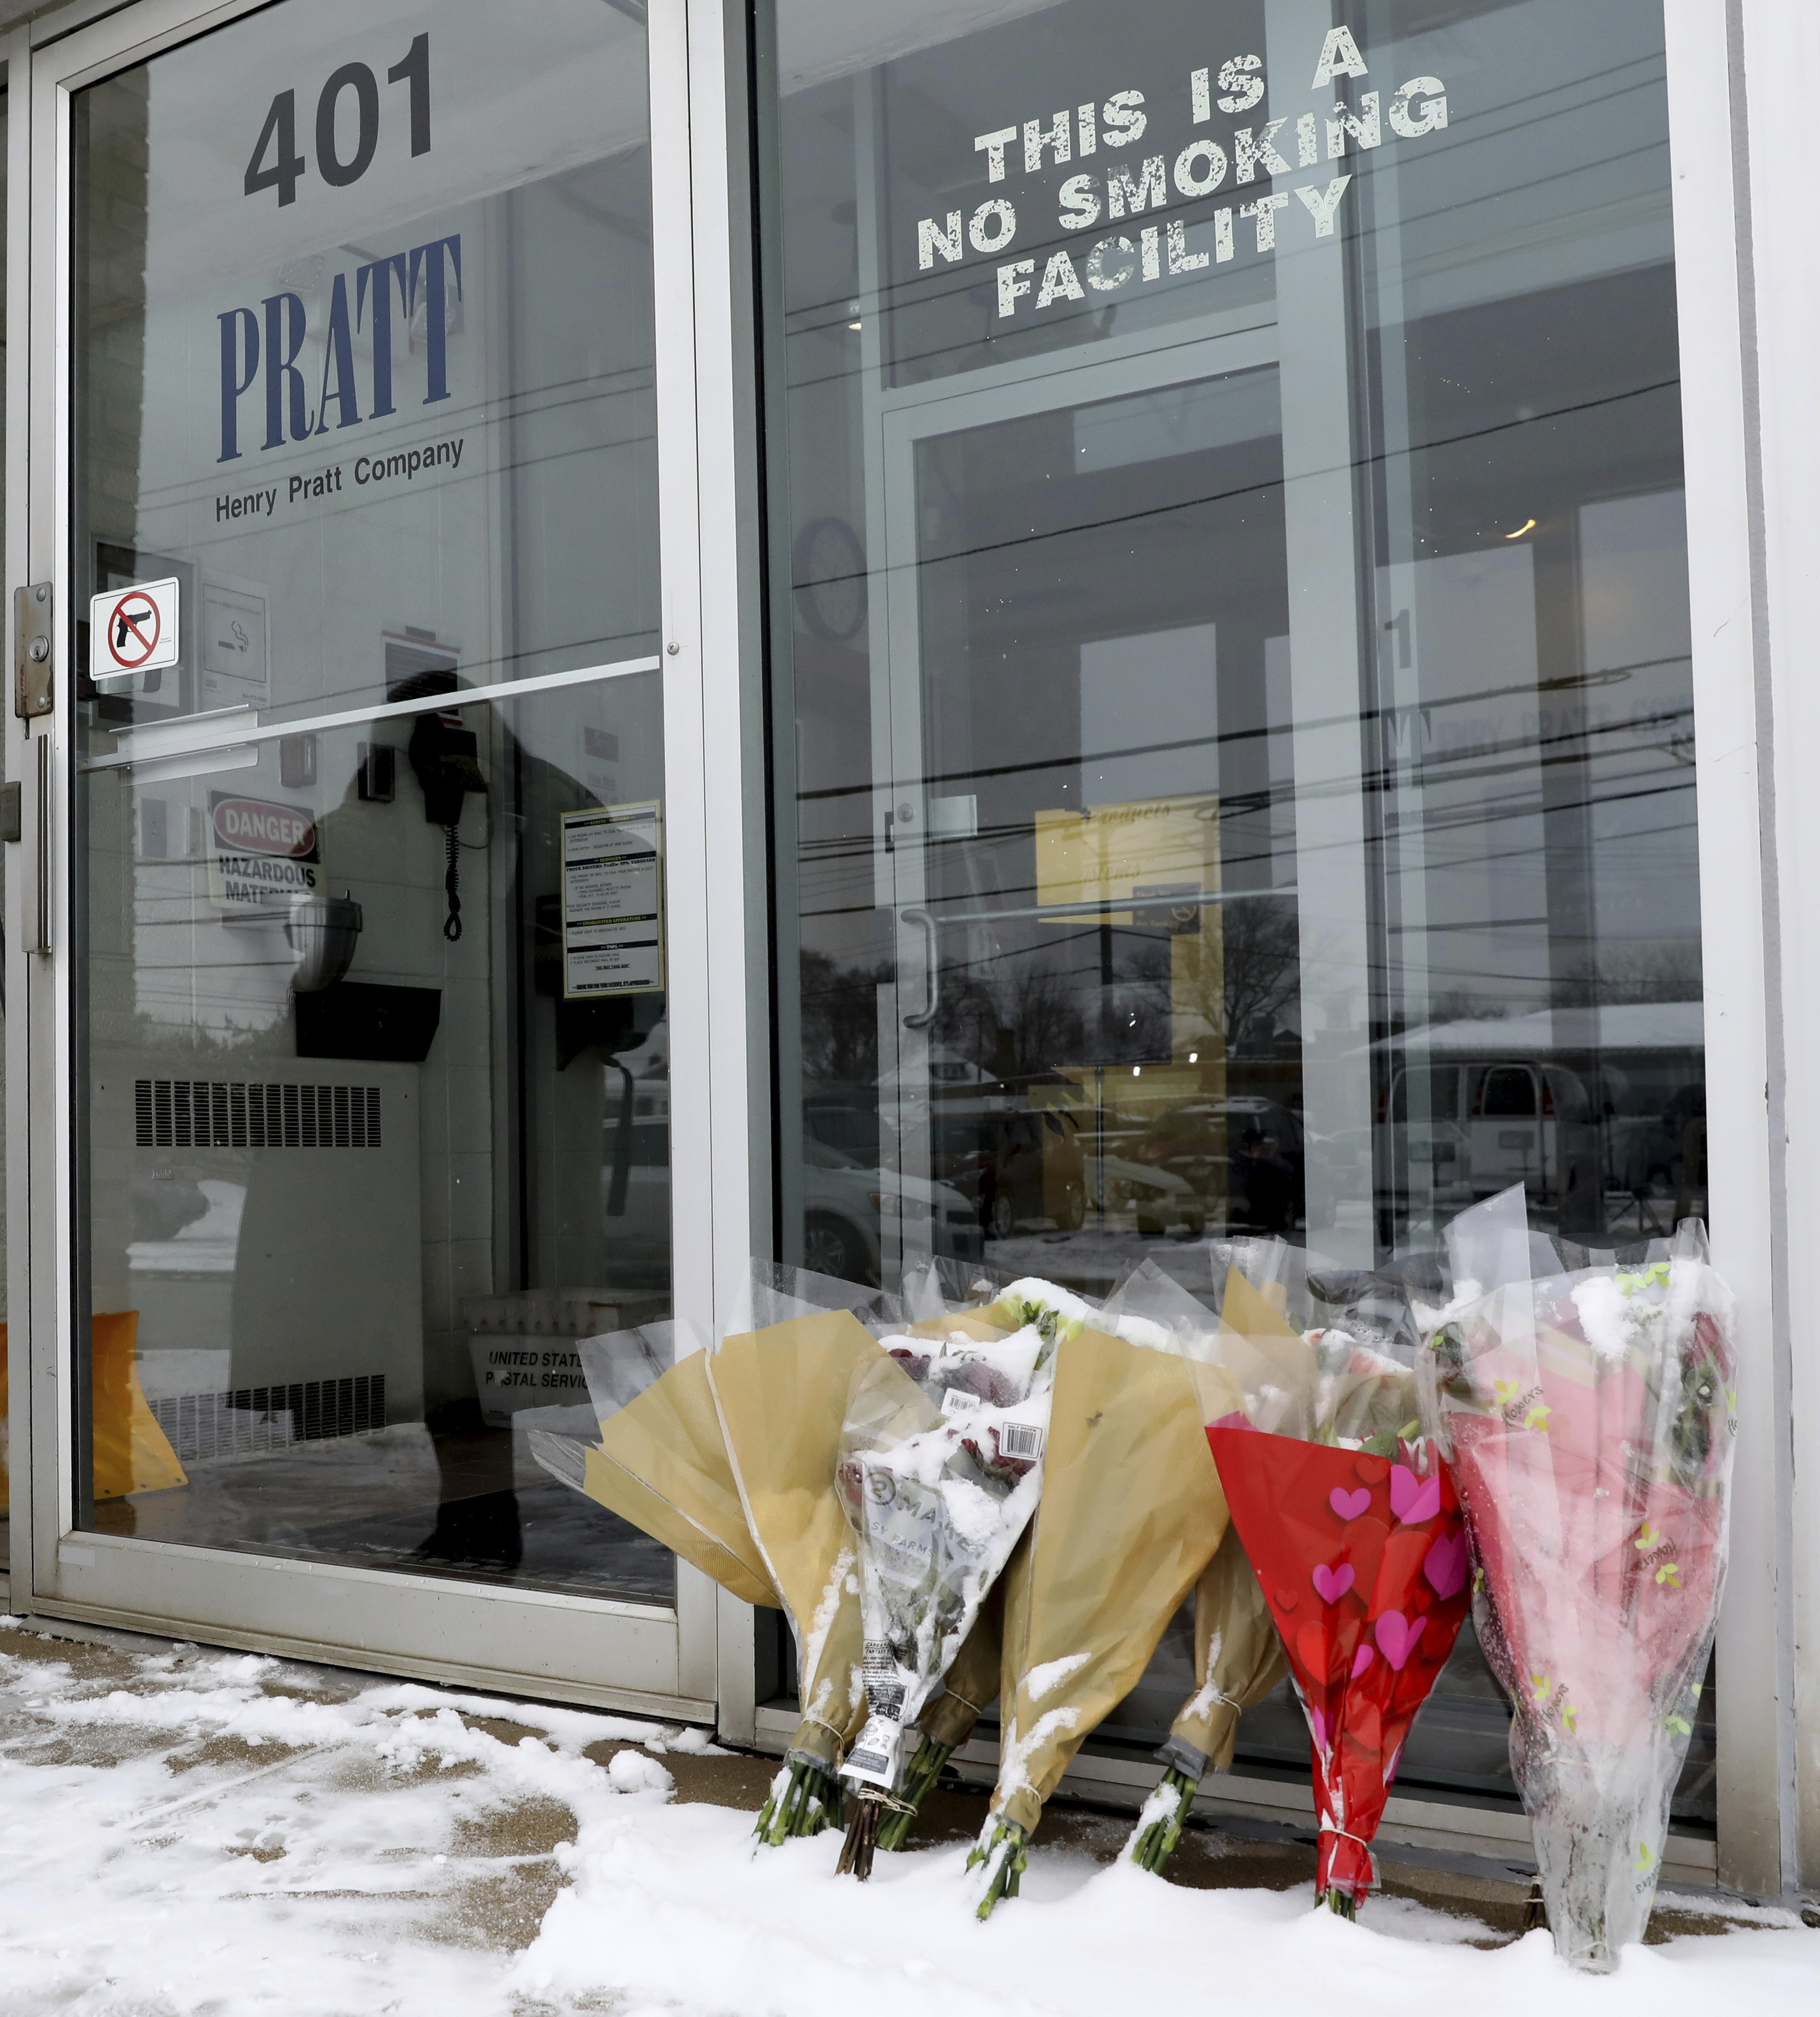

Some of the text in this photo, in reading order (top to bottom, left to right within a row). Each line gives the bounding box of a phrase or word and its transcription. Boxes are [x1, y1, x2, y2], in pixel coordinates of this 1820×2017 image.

[244, 32, 431, 208] 401
[974, 25, 1368, 183] THIS IS A
[919, 75, 1449, 270] NO SMOKING
[996, 173, 1352, 318] FACILITY
[216, 234, 462, 463] PRATT
[216, 438, 465, 524] Henry Pratt Company
[219, 854, 316, 888] HAZARDOUS
[225, 808, 306, 846] DANGER
[485, 1371, 589, 1389] PSTAL SERVIC
[489, 1351, 582, 1367] UNITED STATE
